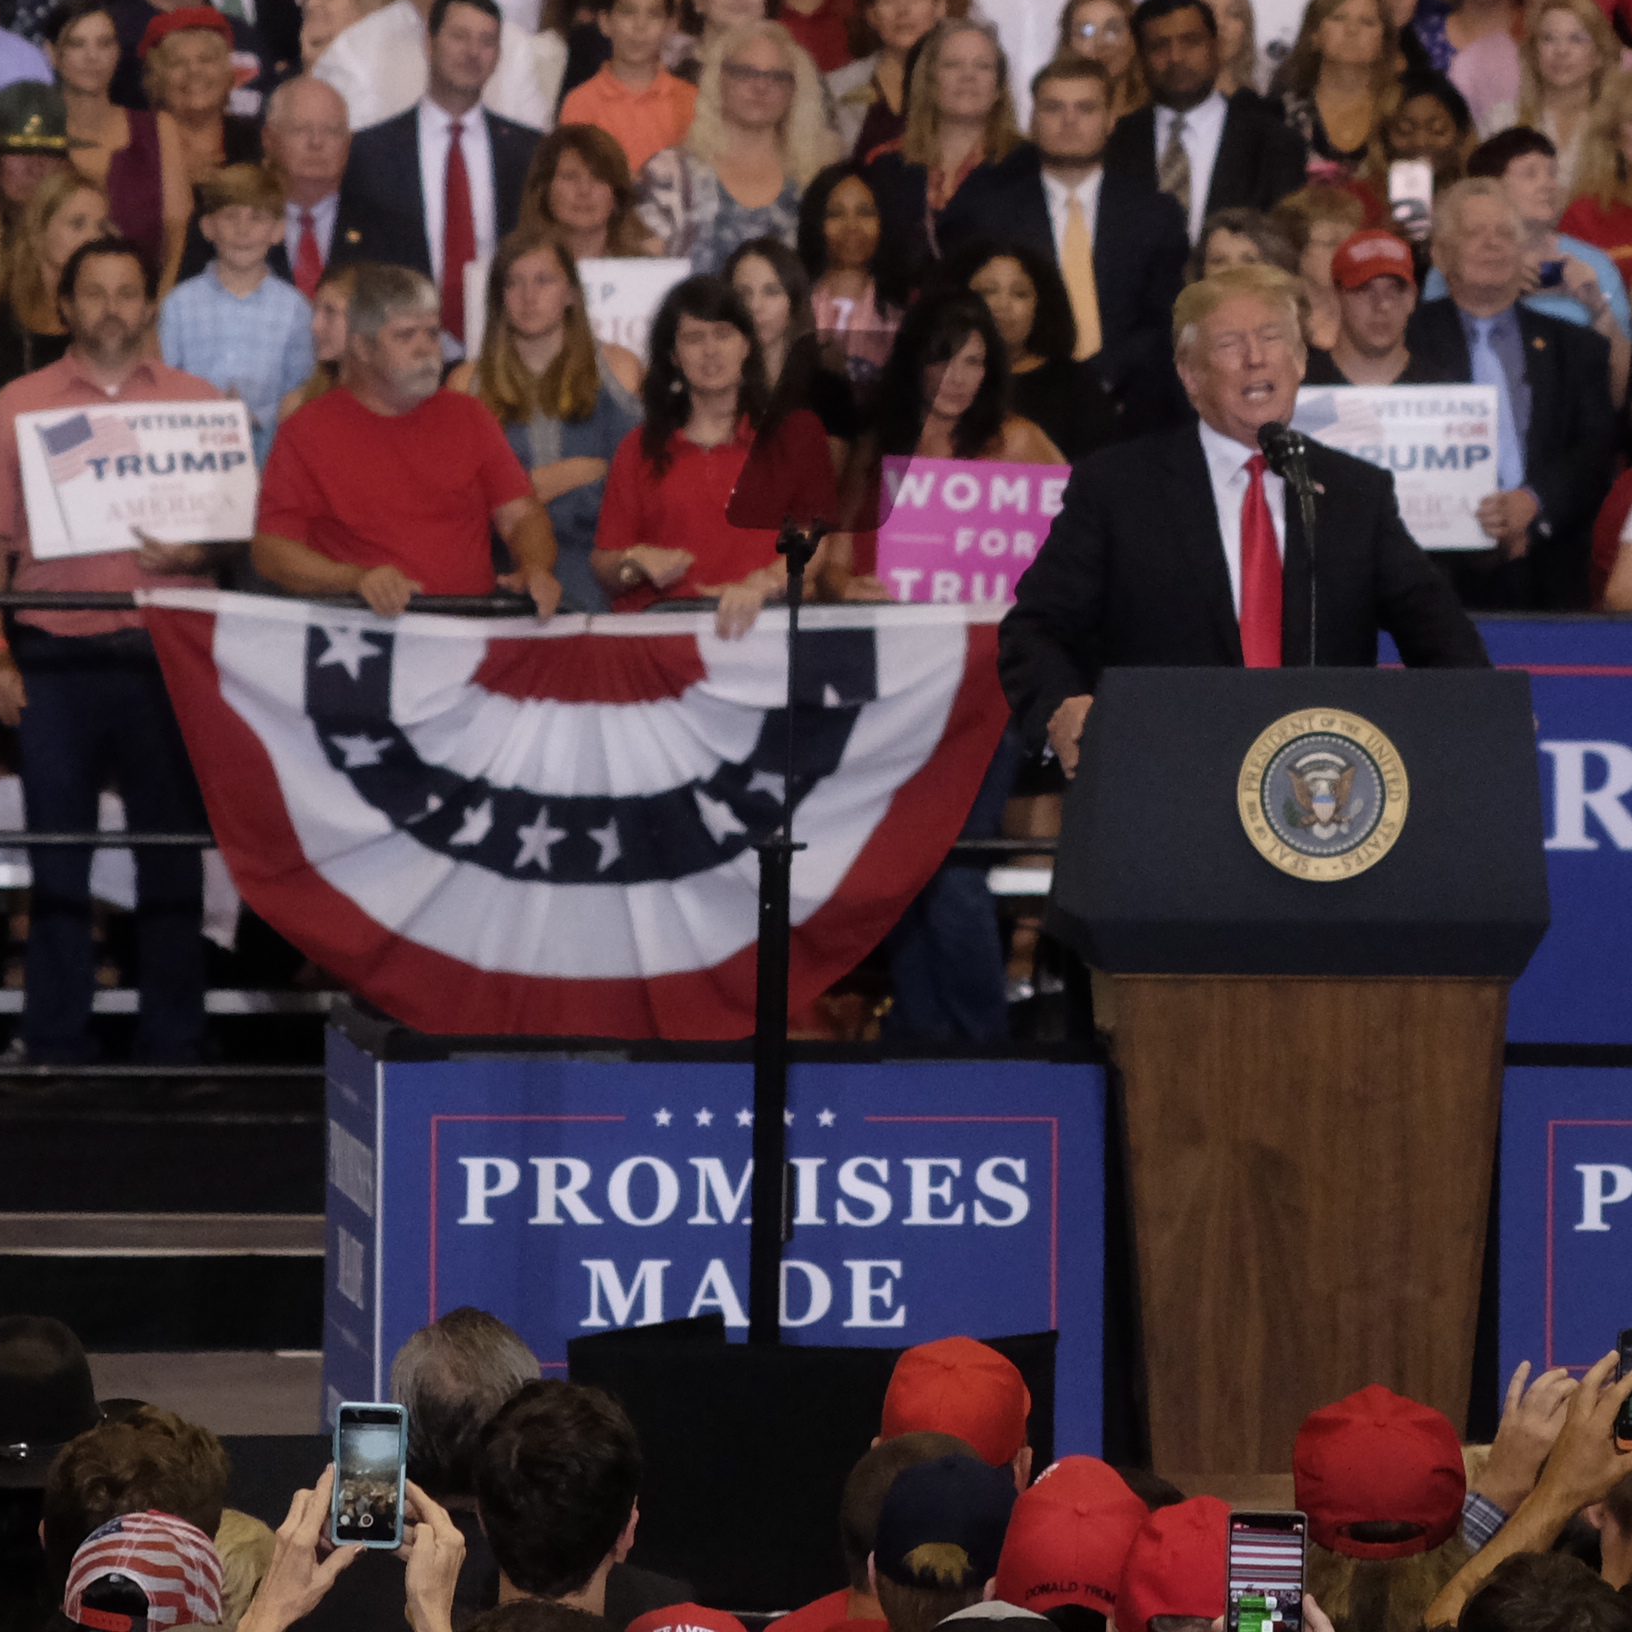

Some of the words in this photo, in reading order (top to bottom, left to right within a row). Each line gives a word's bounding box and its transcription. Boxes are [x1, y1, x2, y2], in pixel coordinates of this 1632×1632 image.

[126, 413, 240, 432] VETERANS
[87, 450, 247, 481] TRUMP
[1353, 443, 1492, 472] RUMP
[884, 468, 1070, 517] WOME
[954, 526, 1038, 559] FOR
[888, 567, 1011, 604] TRU
[457, 1155, 1032, 1228] PROMISES
[579, 1258, 907, 1329] MADE
[1024, 1580, 1079, 1604] DONALD
[1083, 1583, 1119, 1604] TRUM
